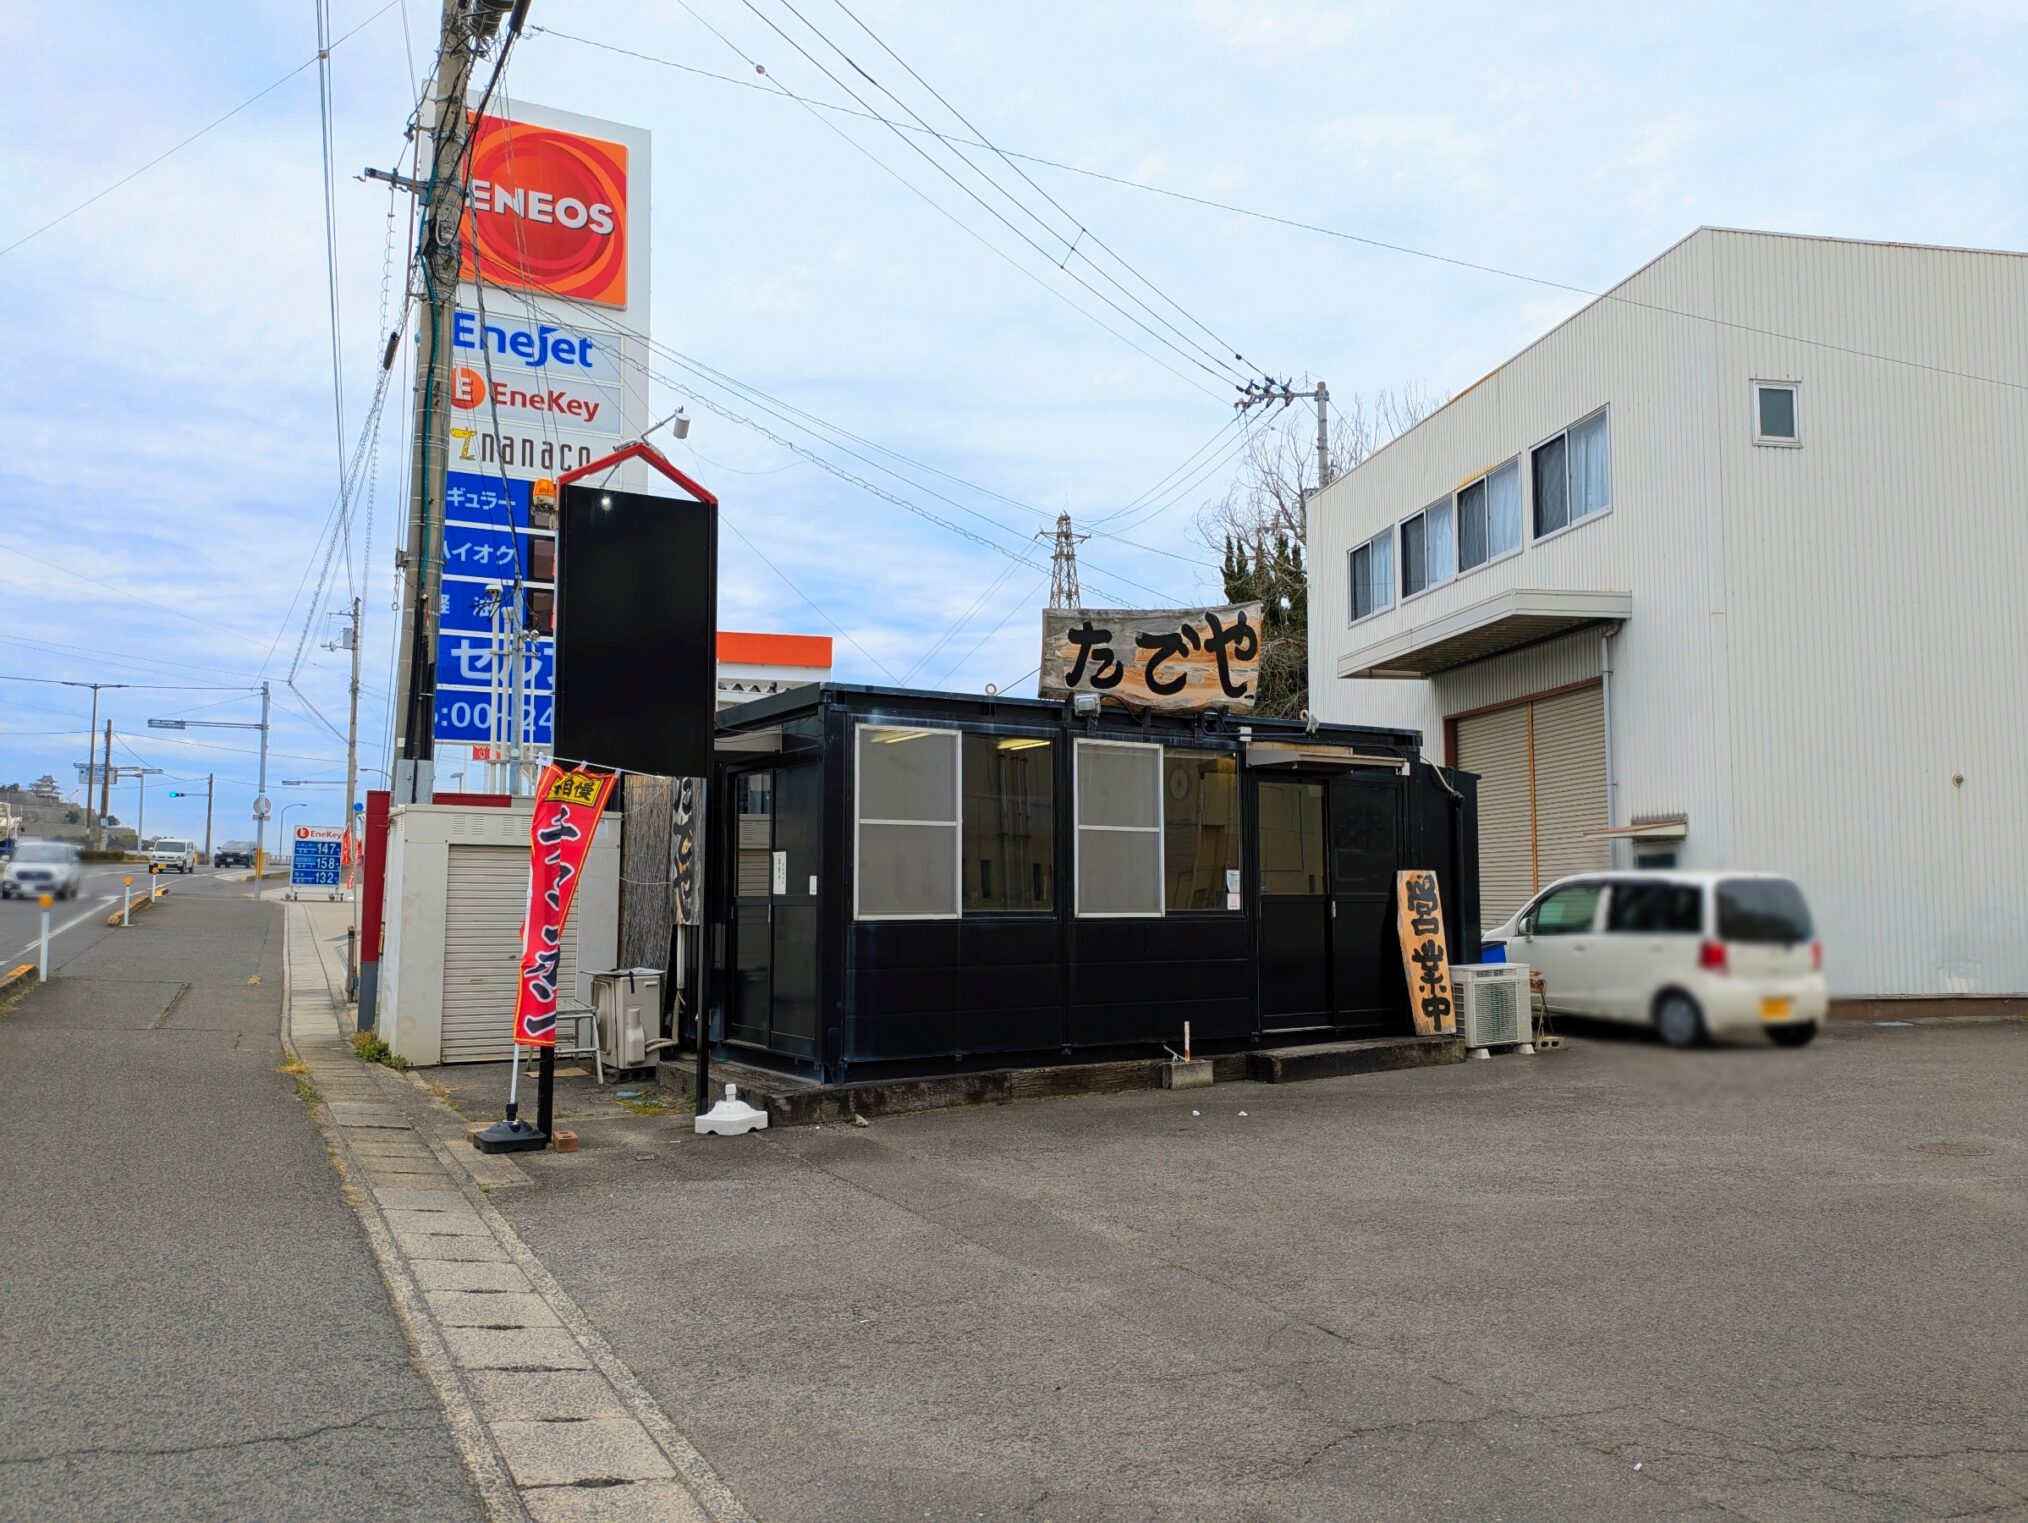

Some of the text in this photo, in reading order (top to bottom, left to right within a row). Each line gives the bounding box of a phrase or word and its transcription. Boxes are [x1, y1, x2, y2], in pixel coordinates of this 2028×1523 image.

[465, 179, 614, 235] ENEOS
[492, 381, 600, 422] EneKey
[451, 639, 554, 684] セル
[1065, 610, 1258, 698] たでや
[310, 830, 343, 839] EneKey
[317, 843, 337, 854] 147
[316, 857, 335, 869] 158
[315, 872, 334, 884] 132
